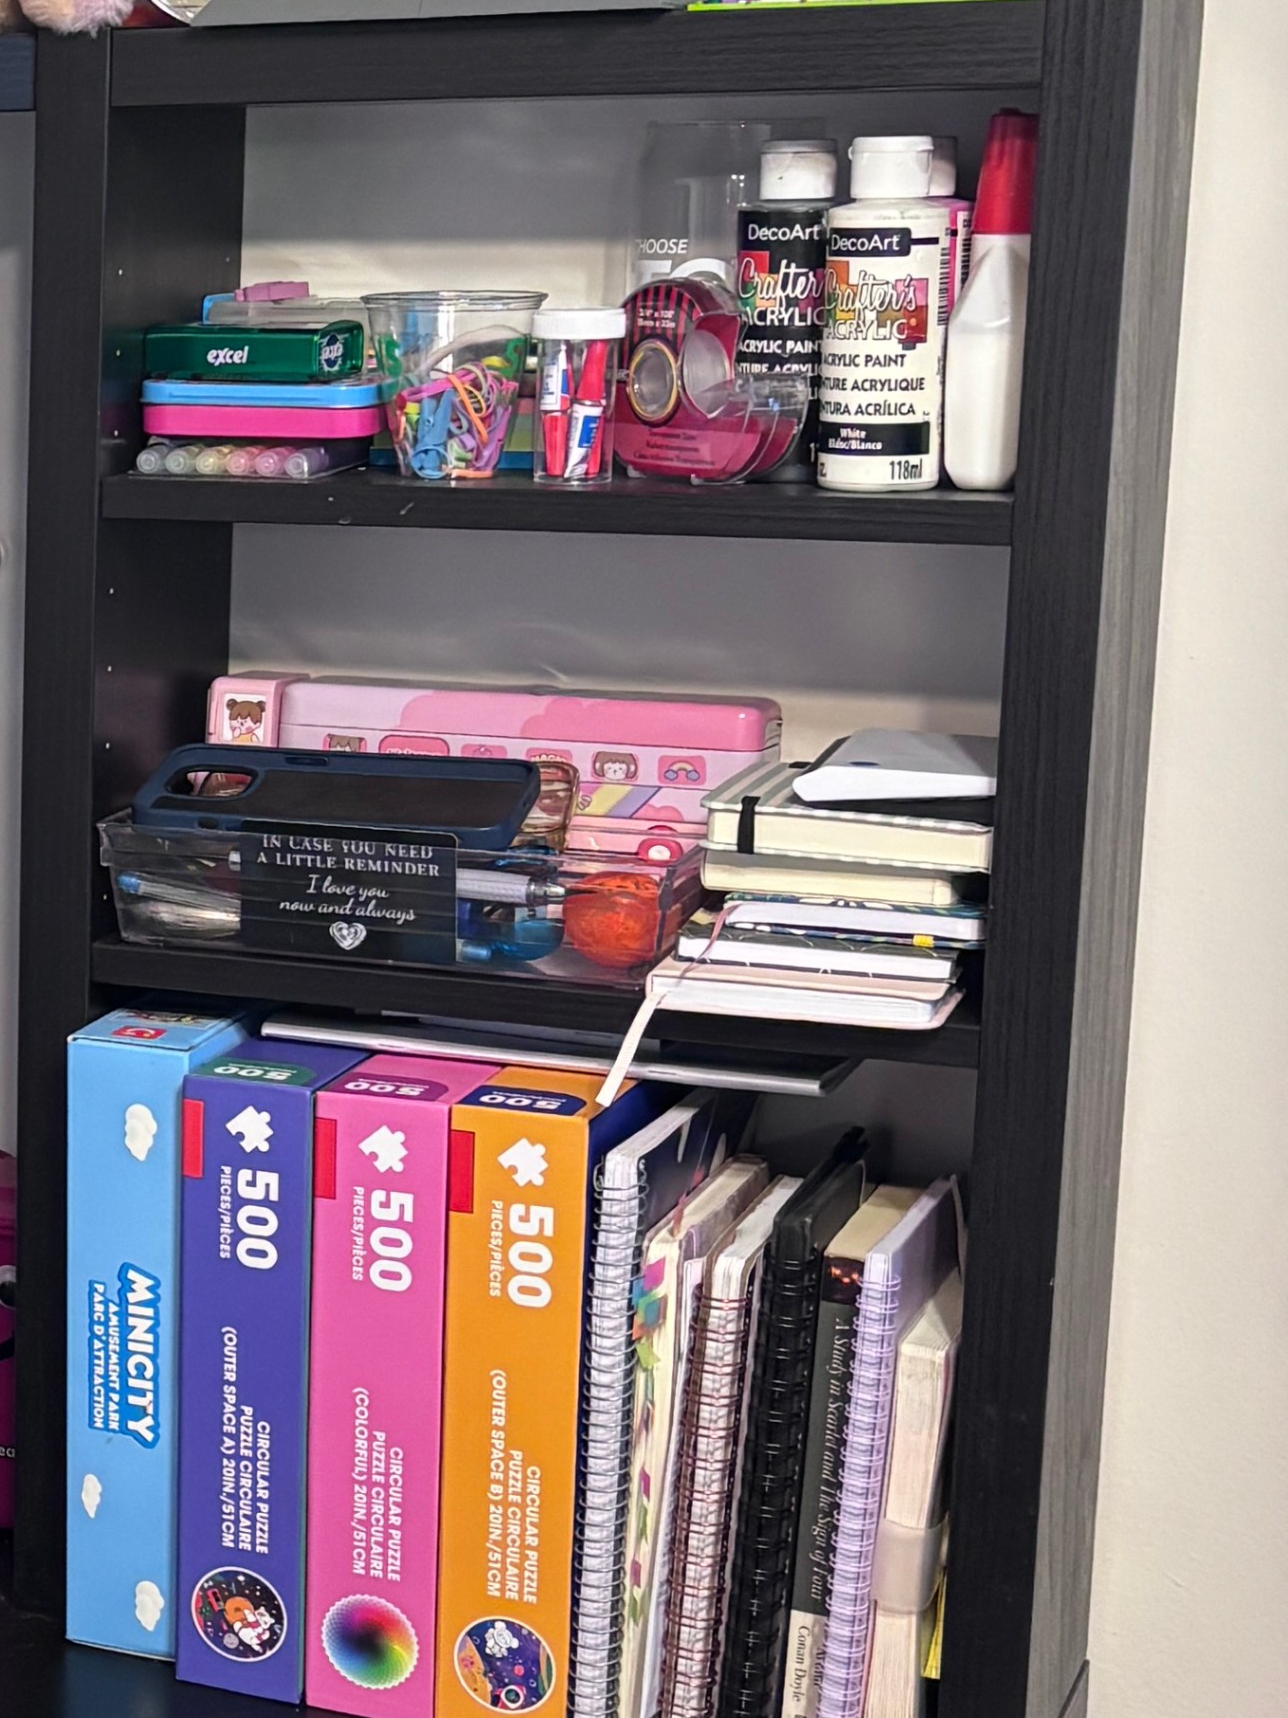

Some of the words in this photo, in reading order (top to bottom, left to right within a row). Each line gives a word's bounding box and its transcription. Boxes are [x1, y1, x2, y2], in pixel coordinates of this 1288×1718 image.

[635, 237, 690, 255] HOOSE
[747, 223, 821, 242] DecoArt
[831, 233, 901, 252] DecoArt
[738, 256, 823, 309] Crafter
[824, 269, 917, 324] Crafter's
[206, 345, 250, 367] excel
[785, 339, 823, 355] PAIN
[864, 353, 908, 368] PAINT
[822, 376, 848, 391] TURE
[850, 377, 926, 393] ACRYLIQUE
[822, 401, 852, 417] TURA
[853, 399, 916, 417] ACRÍLICA
[839, 427, 867, 440] White
[888, 457, 923, 481] 118ml
[256, 851, 269, 864] A
[275, 852, 337, 870] LITTLE
[343, 858, 441, 877] REMINDER
[262, 834, 282, 849] IN
[288, 835, 334, 853] CASE
[341, 839, 377, 855] YOU
[384, 842, 434, 860] NEED
[278, 901, 316, 912] now
[317, 898, 354, 916] and
[354, 899, 417, 926] always
[305, 873, 321, 895] I
[321, 875, 357, 896] love
[357, 886, 390, 902] you
[343, 1080, 422, 1097] 500
[478, 1093, 562, 1111] 500
[217, 1165, 234, 1259] PIECES/PIÈCES
[235, 1168, 280, 1270] 500
[350, 1185, 367, 1281] PIECES/PIÈCES
[368, 1188, 415, 1293] 500
[487, 1199, 506, 1298] PIECES/PIÈCES
[506, 1202, 555, 1309] 500
[93, 1282, 106, 1323] PARC
[834, 1317, 851, 1332] A
[107, 1301, 120, 1391] AMUSEMENT
[125, 1267, 156, 1443] MINICITY
[221, 1325, 238, 1383] (OUTER
[825, 1334, 850, 1376] Study
[93, 1325, 107, 1429] D'ATTRACTION
[489, 1368, 507, 1427] (OUTER
[828, 1379, 846, 1397] in
[107, 1392, 120, 1431] PARK
[222, 1384, 237, 1435] SPACE
[239, 1404, 254, 1458] PUZZLE
[351, 1386, 370, 1482] (COLORFUL)
[825, 1399, 845, 1449] Scarlet
[219, 1435, 236, 1455] A)
[255, 1420, 271, 1500] CIRCULAR
[371, 1430, 386, 1485] PUZZLE
[489, 1429, 506, 1483] SPACE
[821, 1450, 838, 1480] and
[388, 1446, 404, 1527] CIRCULAR
[486, 1484, 504, 1502] B)
[507, 1448, 524, 1505] PUZZLE
[238, 1459, 253, 1552] CIRCULAIRE
[255, 1501, 270, 1555] PUZZLE
[524, 1465, 541, 1548] CIRCULAR
[811, 1514, 833, 1547] Sign
[369, 1486, 385, 1579] CIRCULAIRE
[387, 1528, 402, 1583] PUZZLE
[504, 1506, 522, 1602] CIRCULAIRE
[522, 1548, 539, 1605] PUZZLE
[809, 1548, 830, 1568] of
[794, 1625, 811, 1665] Conan
[789, 1668, 808, 1703] Doyle
